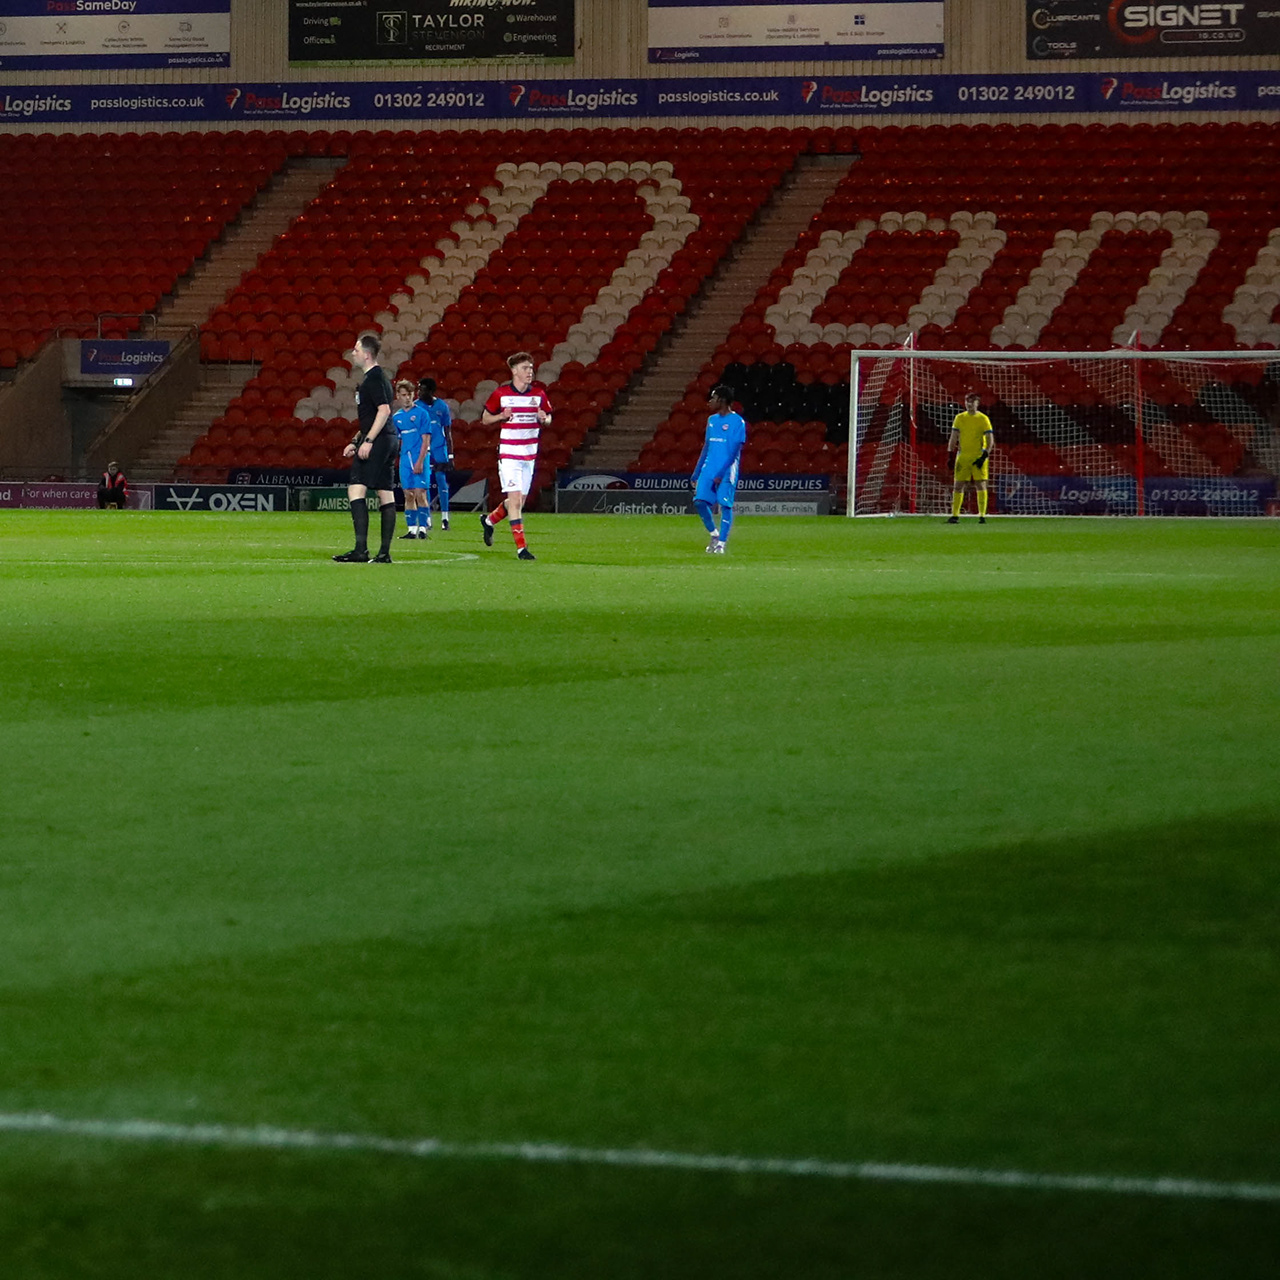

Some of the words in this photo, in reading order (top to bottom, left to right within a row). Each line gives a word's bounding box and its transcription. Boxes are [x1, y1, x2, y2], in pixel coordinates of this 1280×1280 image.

[303, 16, 329, 27] Driving
[412, 14, 486, 29] TAYLOR
[515, 14, 558, 23] Warehouse
[1123, 4, 1246, 28] SIGNET
[512, 32, 558, 44] Engineering
[424, 43, 466, 52] RECRUITMENT
[1046, 41, 1078, 50] TOOLS
[822, 83, 934, 107] PassLogistics
[958, 86, 1009, 102] 01302
[1014, 85, 1076, 101] 249012
[1121, 80, 1237, 104] PassLogistics
[90, 94, 205, 111] passlogistics.co.uk
[244, 90, 352, 113] PassLogistics
[373, 92, 423, 108] 01302
[426, 91, 485, 108] 249012
[528, 88, 639, 110] PassLogistics
[658, 88, 779, 105] passlogistics.co.uk
[256, 473, 325, 486] ALBEMARLE
[633, 477, 689, 490] BUILDING
[736, 479, 765, 490] BING
[767, 478, 823, 490] SUPPLIES
[43, 489, 69, 500] when
[69, 490, 91, 500] care
[1150, 489, 1197, 501] 01302
[208, 492, 275, 512] OXEN
[316, 497, 351, 511] JAMES
[613, 501, 658, 515] district
[661, 501, 688, 515] four
[755, 504, 779, 513] Build.
[781, 504, 815, 513] Furnish.
